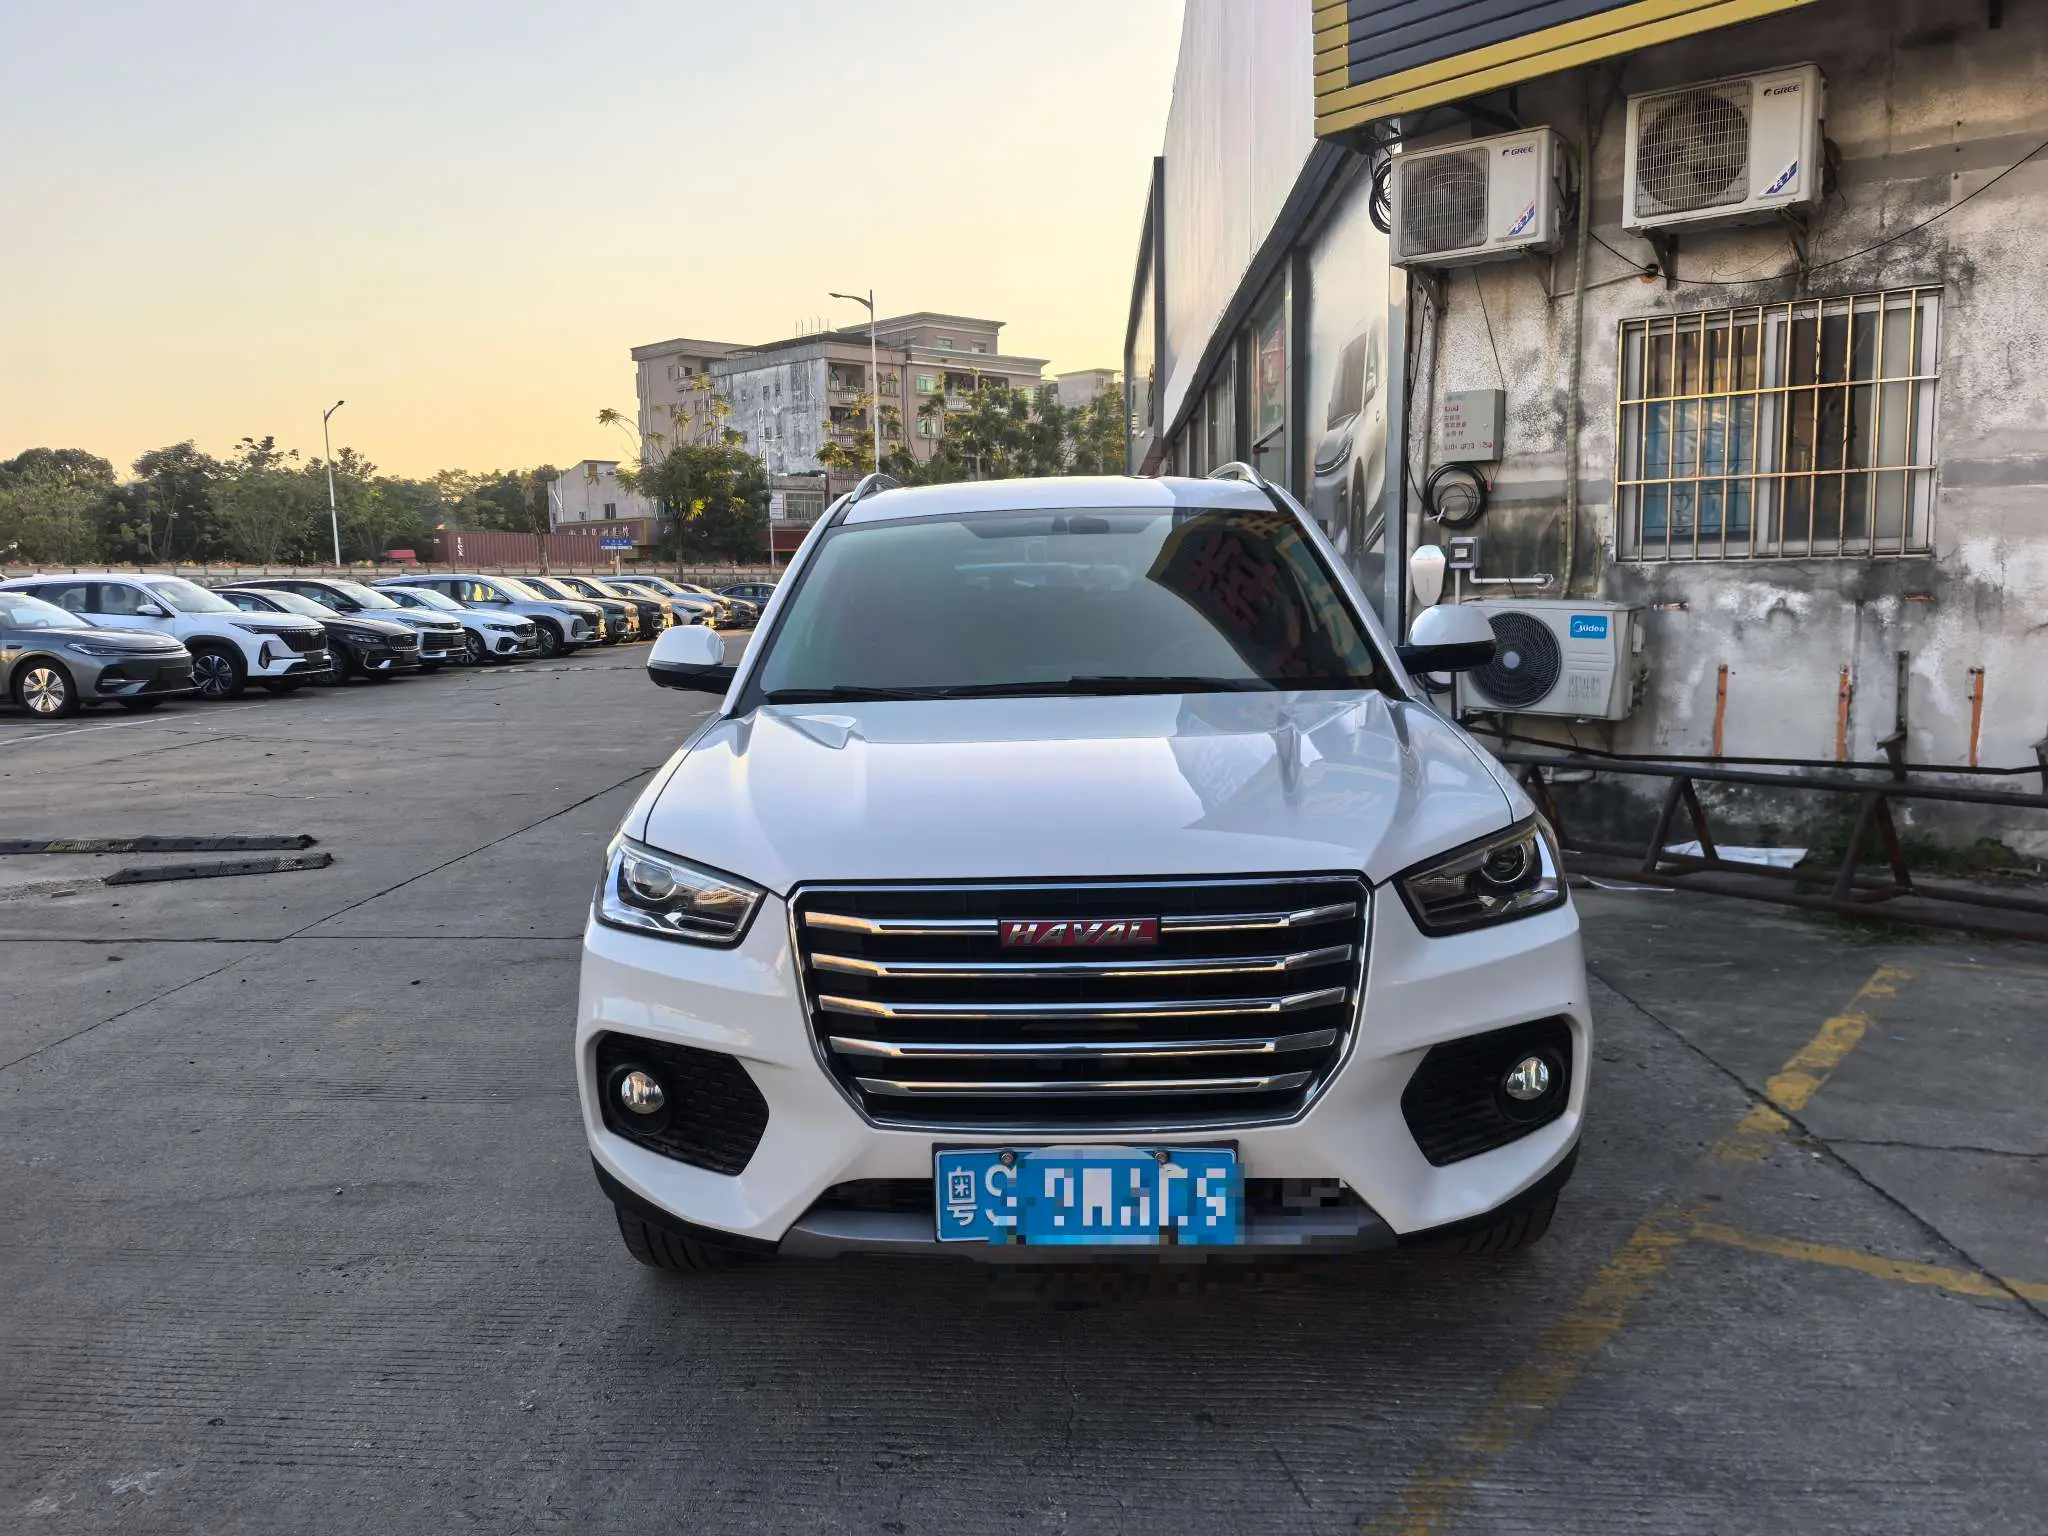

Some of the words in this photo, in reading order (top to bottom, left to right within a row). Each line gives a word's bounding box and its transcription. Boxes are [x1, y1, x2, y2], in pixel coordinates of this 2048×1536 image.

[1773, 83, 1800, 96] GREE
[1575, 620, 1605, 633] Midea
[1008, 921, 1153, 944] HAVAL
